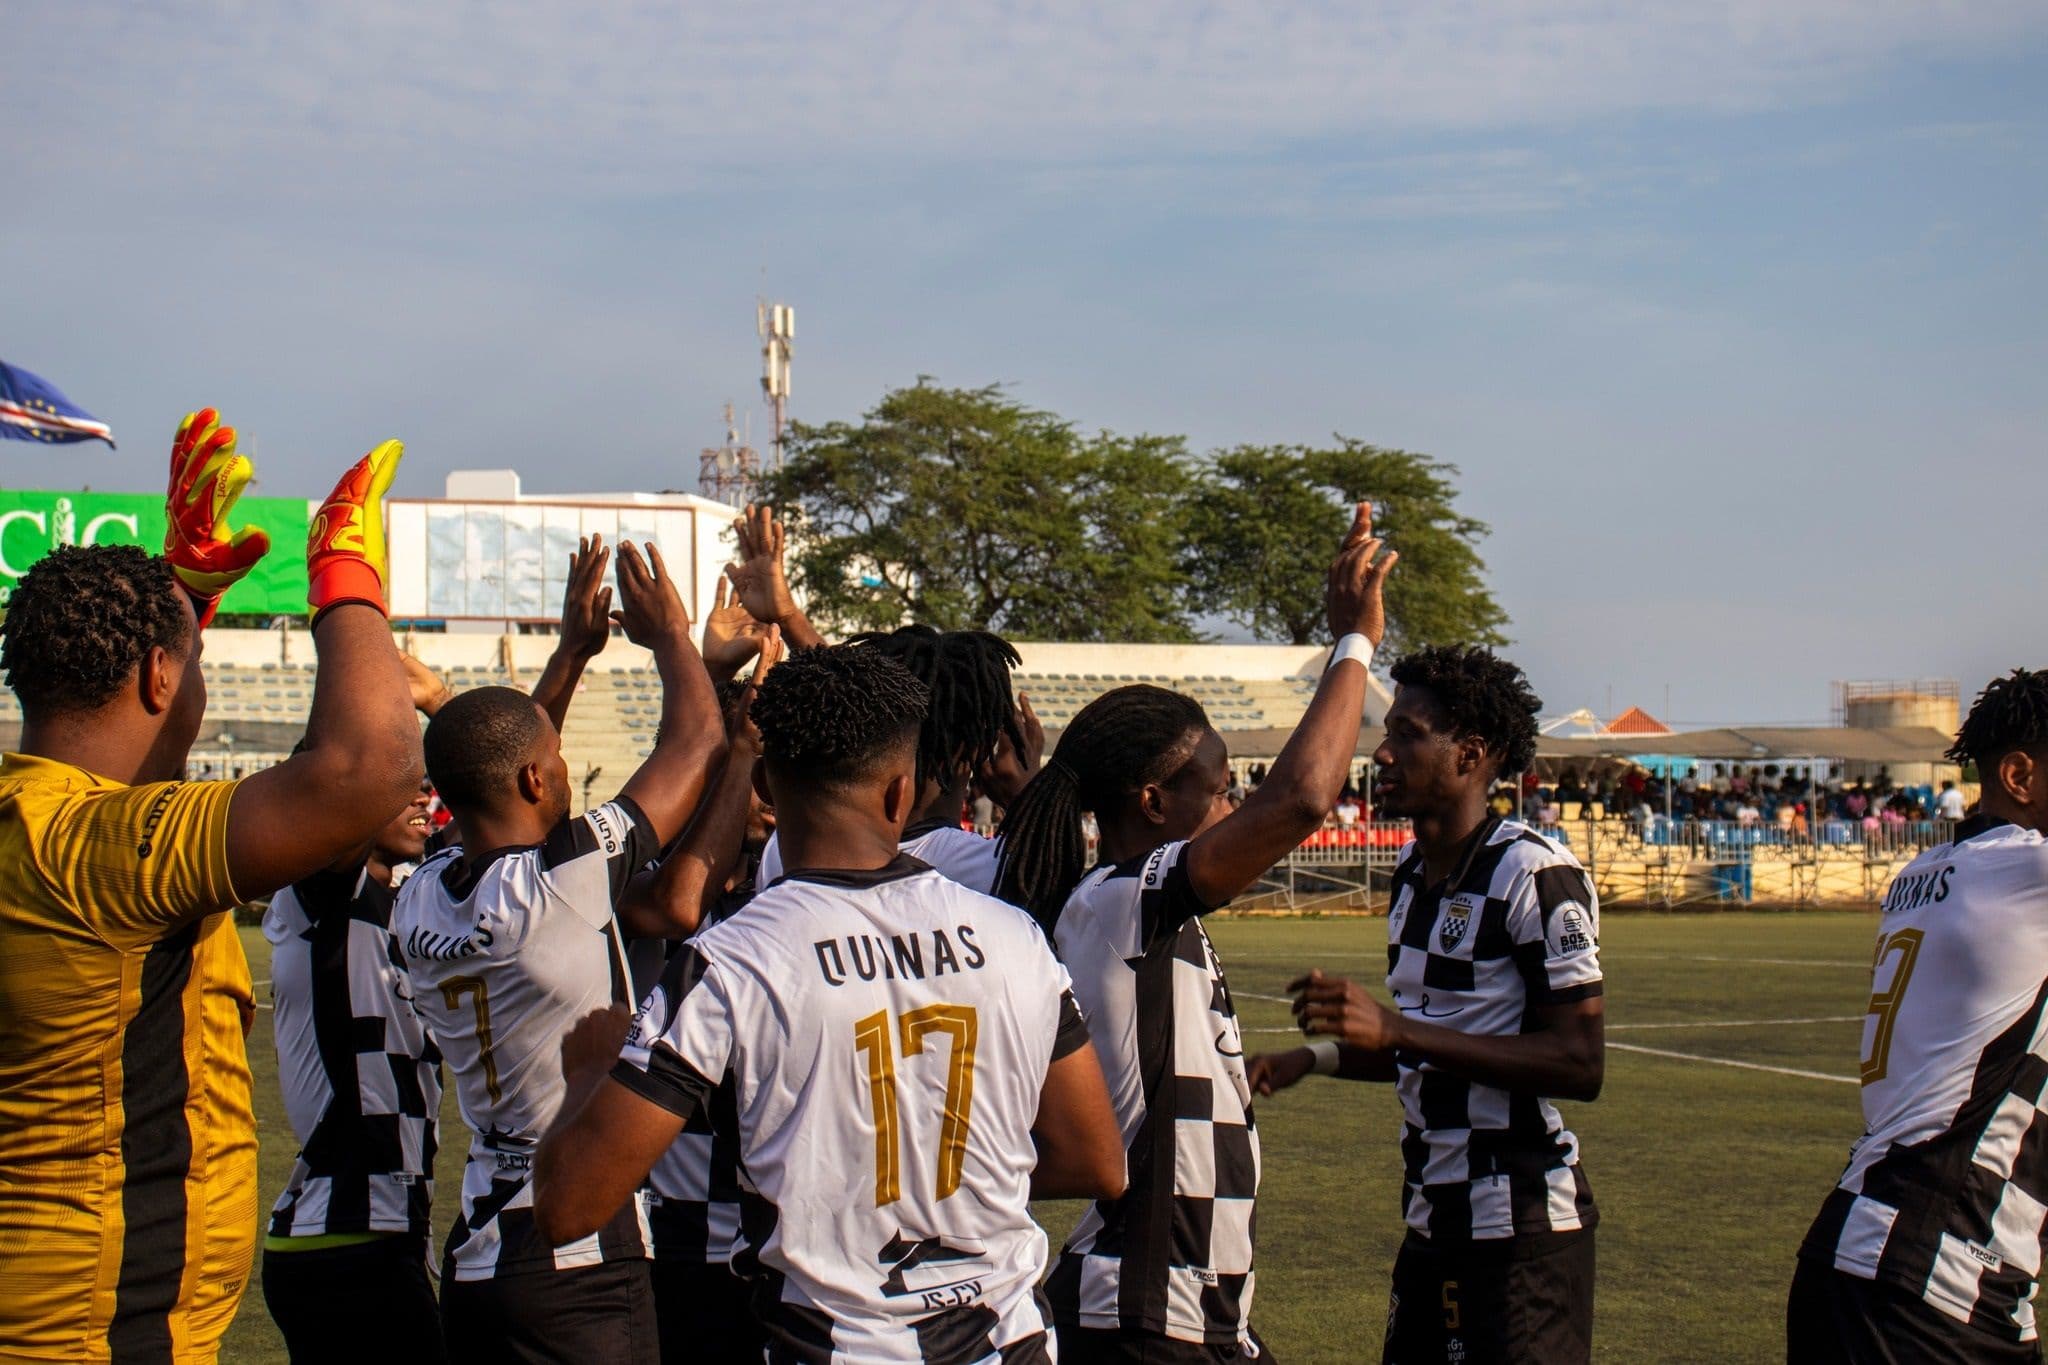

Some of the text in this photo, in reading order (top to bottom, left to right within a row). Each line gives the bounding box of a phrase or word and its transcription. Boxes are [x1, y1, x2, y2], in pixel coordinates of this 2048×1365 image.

[813, 924, 985, 986] QUINAS
[438, 975, 502, 1108] 7
[853, 1003, 977, 1208] 17
[1442, 1281, 1460, 1329] 5
